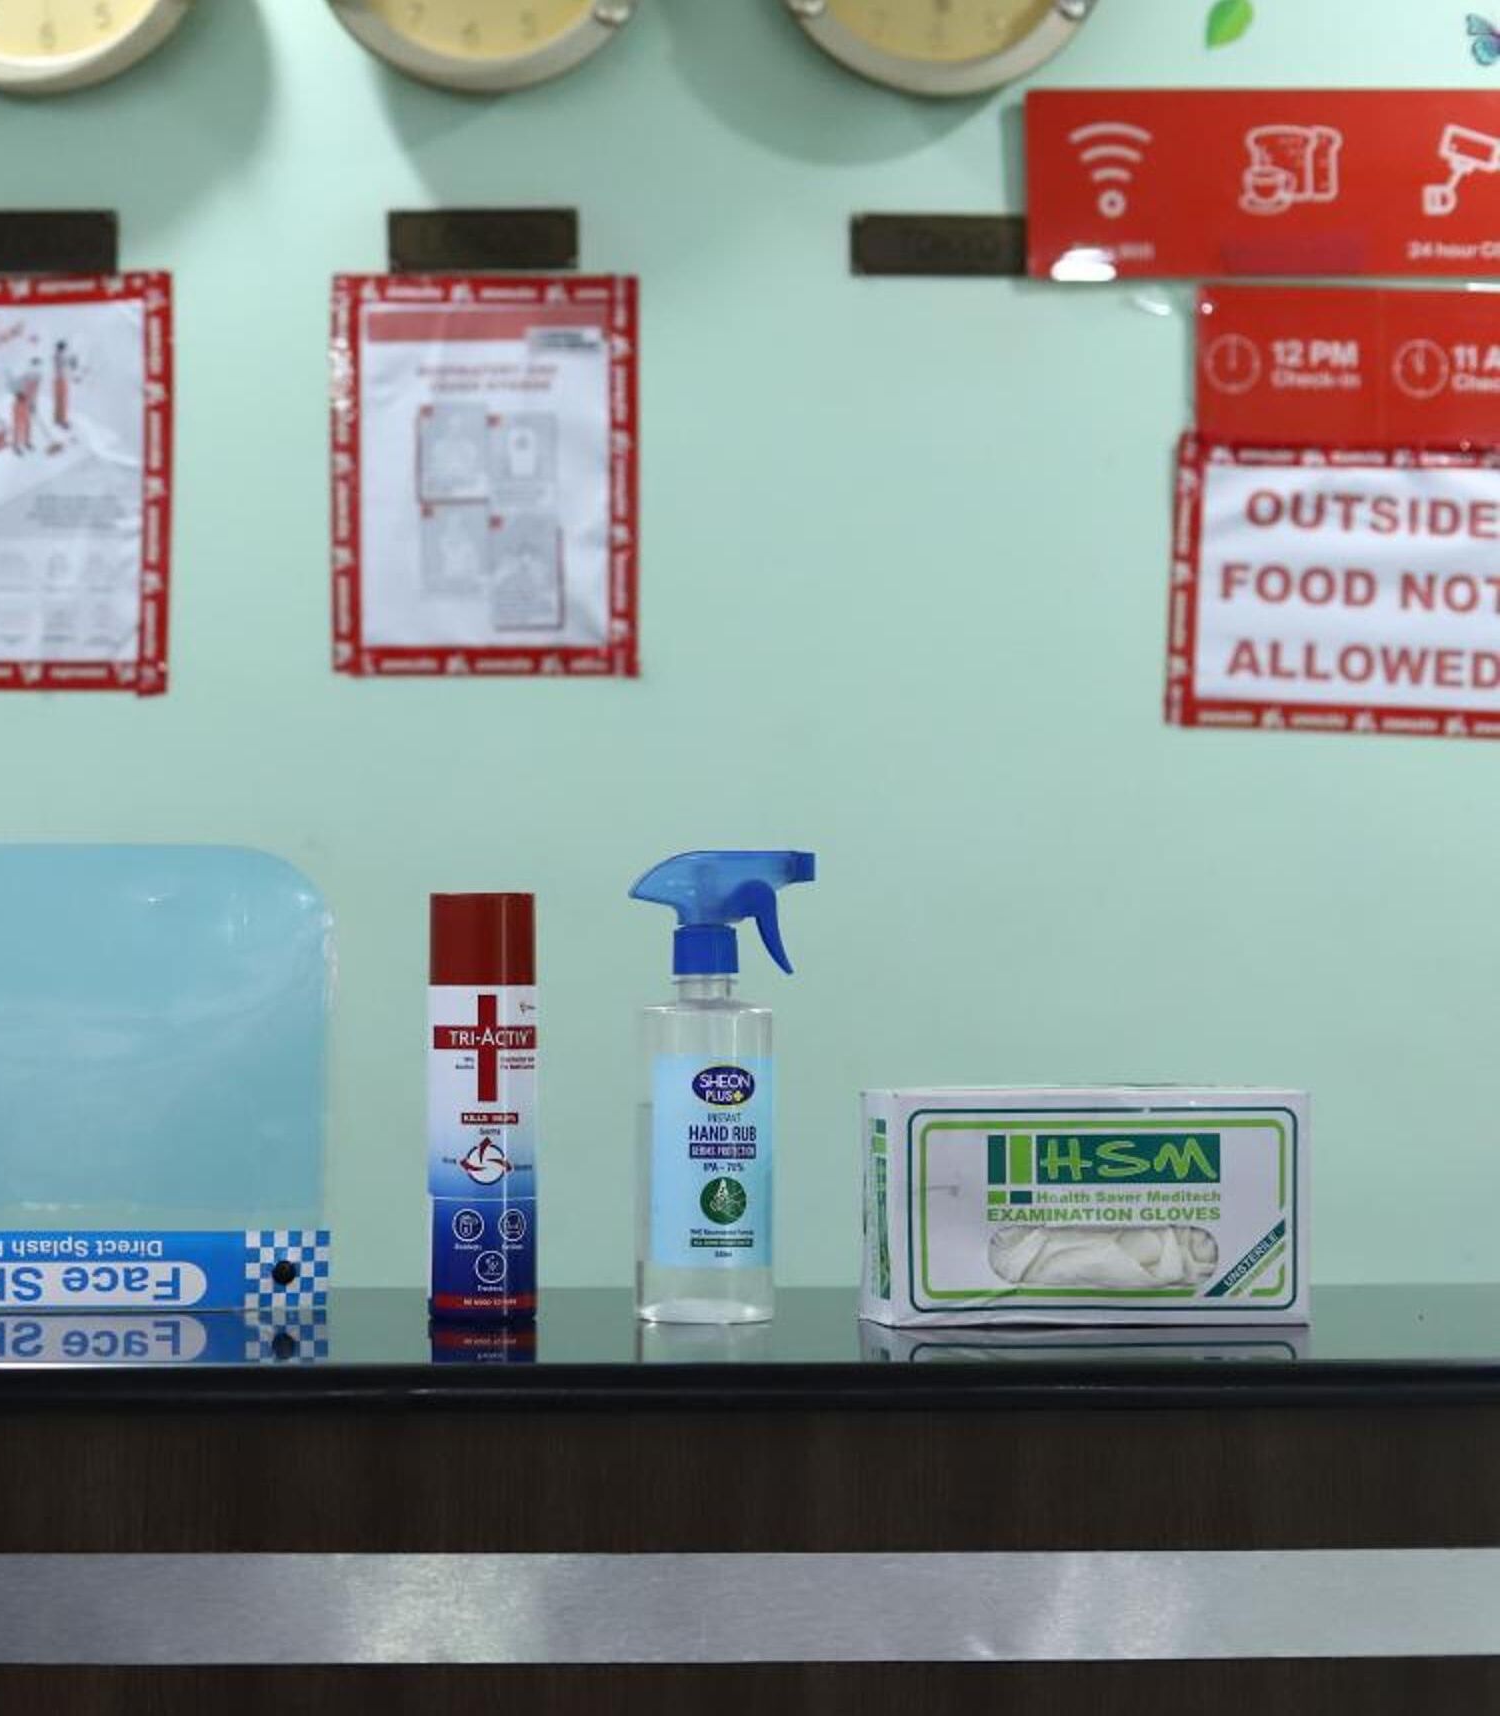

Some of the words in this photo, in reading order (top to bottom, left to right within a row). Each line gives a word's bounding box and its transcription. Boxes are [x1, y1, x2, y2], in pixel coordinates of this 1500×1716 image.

[1272, 339, 1302, 366] 12
[1308, 339, 1359, 368] PM
[1454, 345, 1477, 370] 11
[1246, 490, 1499, 538] OUTSIDE
[1219, 562, 1377, 607] FOOD
[1227, 639, 1500, 689] ALLOWED
[449, 1027, 530, 1046] TRI-ACTIV
[699, 1073, 751, 1089] SHEON
[689, 1126, 729, 1141] HAND
[733, 1126, 757, 1141] RUB
[1039, 1136, 1218, 1181] HSM
[1036, 1191, 1092, 1203] Health
[1147, 1190, 1220, 1203] Meditech
[987, 1208, 1132, 1221] EXAMINATION
[1140, 1208, 1220, 1221] GLOVES
[12, 1236, 89, 1257] Splash
[97, 1240, 163, 1257] Direct
[62, 1266, 181, 1301] Face
